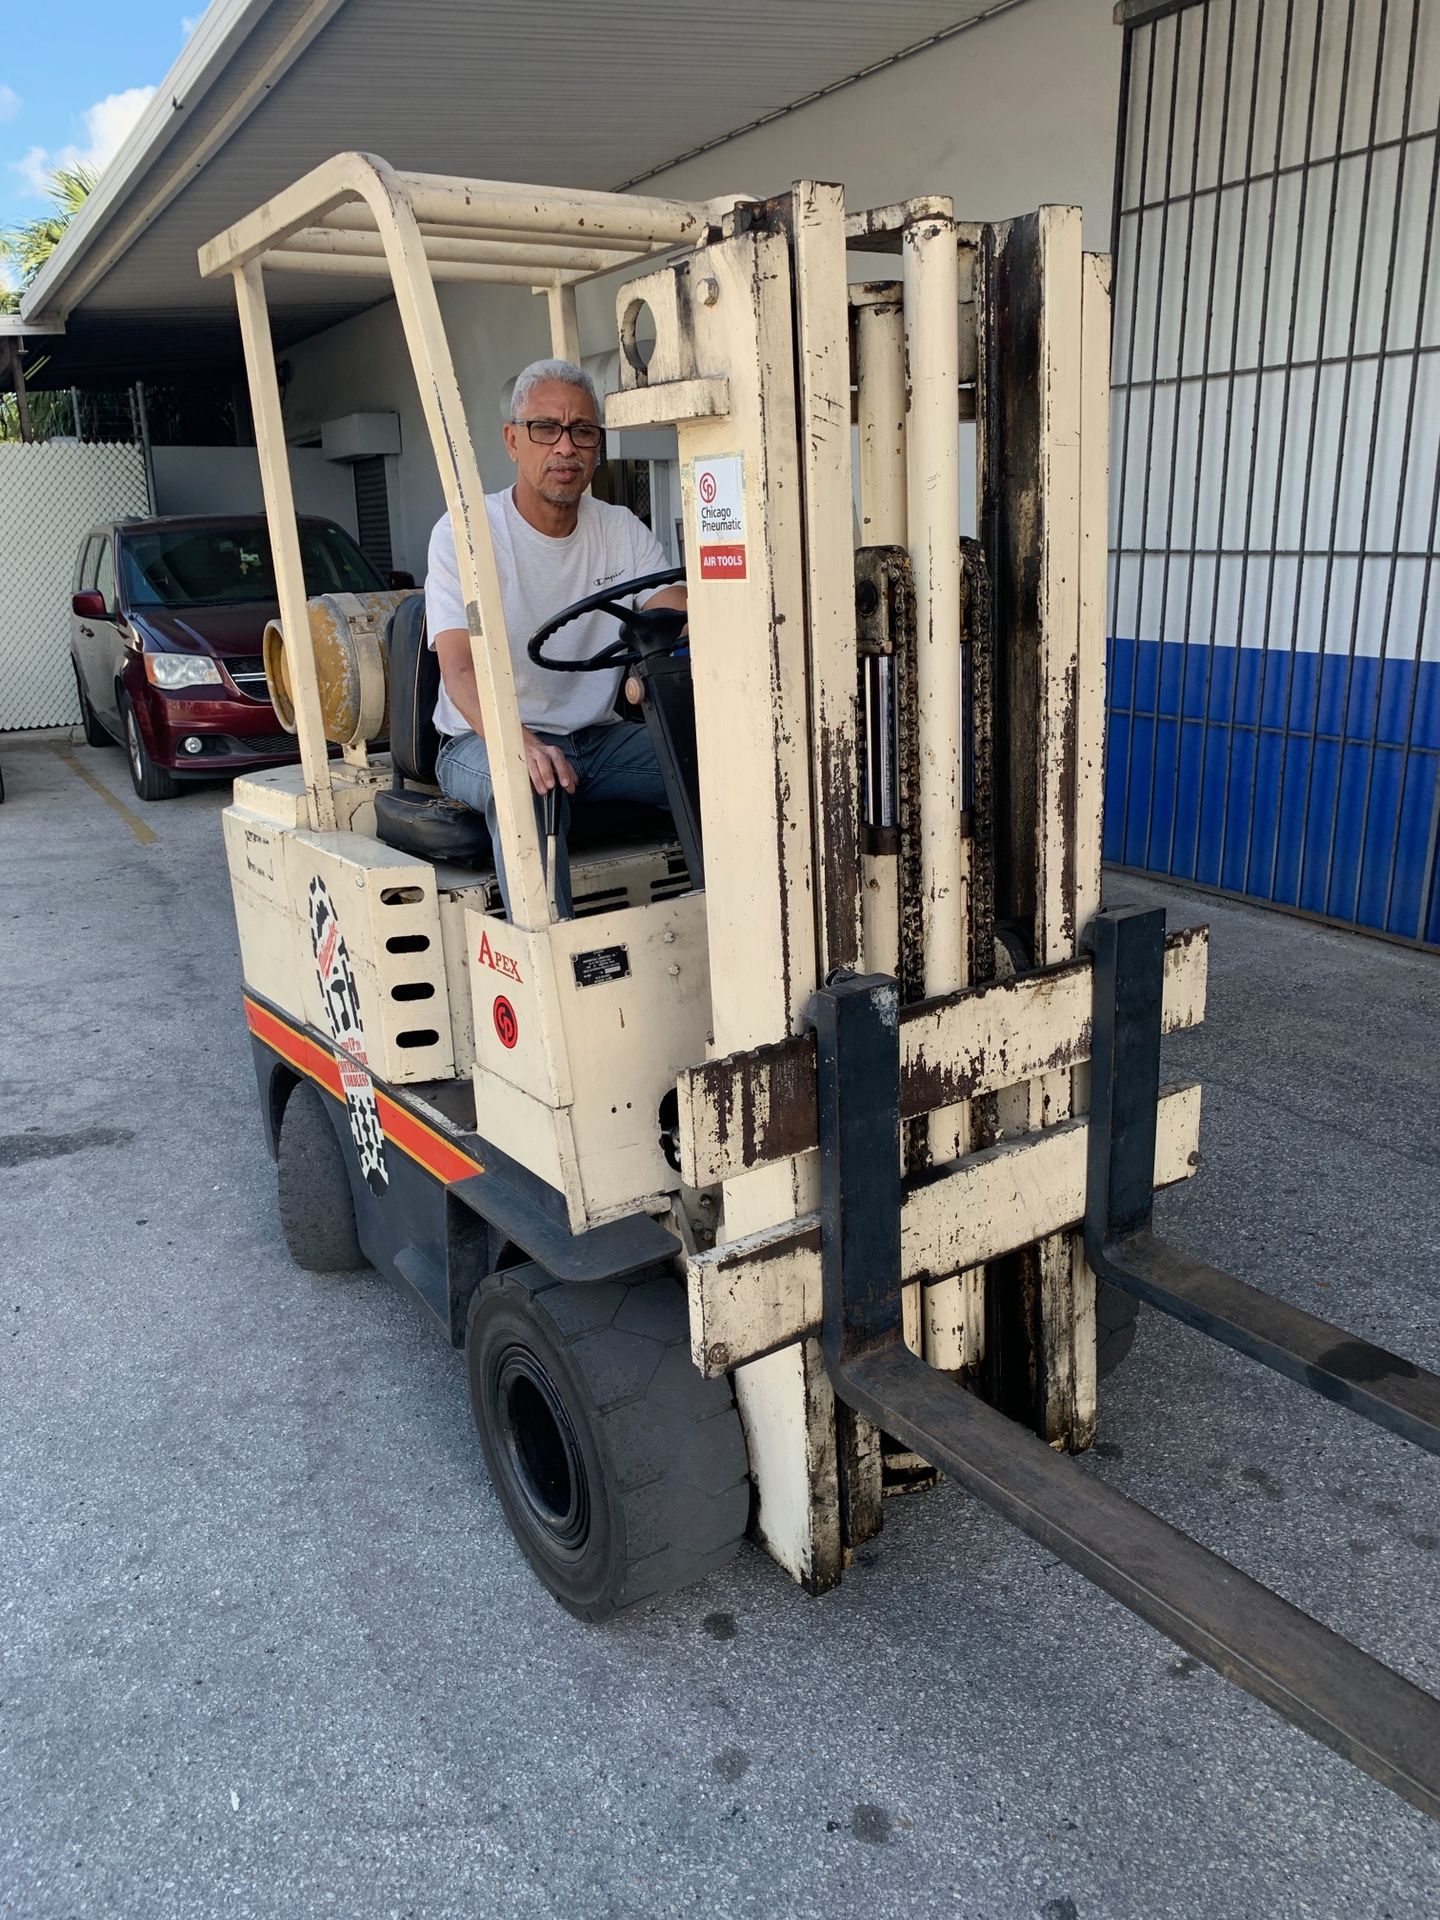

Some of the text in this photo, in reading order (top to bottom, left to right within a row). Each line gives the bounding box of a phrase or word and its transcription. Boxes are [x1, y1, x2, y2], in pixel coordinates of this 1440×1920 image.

[701, 506, 732, 521] Chicago
[702, 518, 742, 532] Pneumatic
[703, 555, 743, 567] AIR TOOLS
